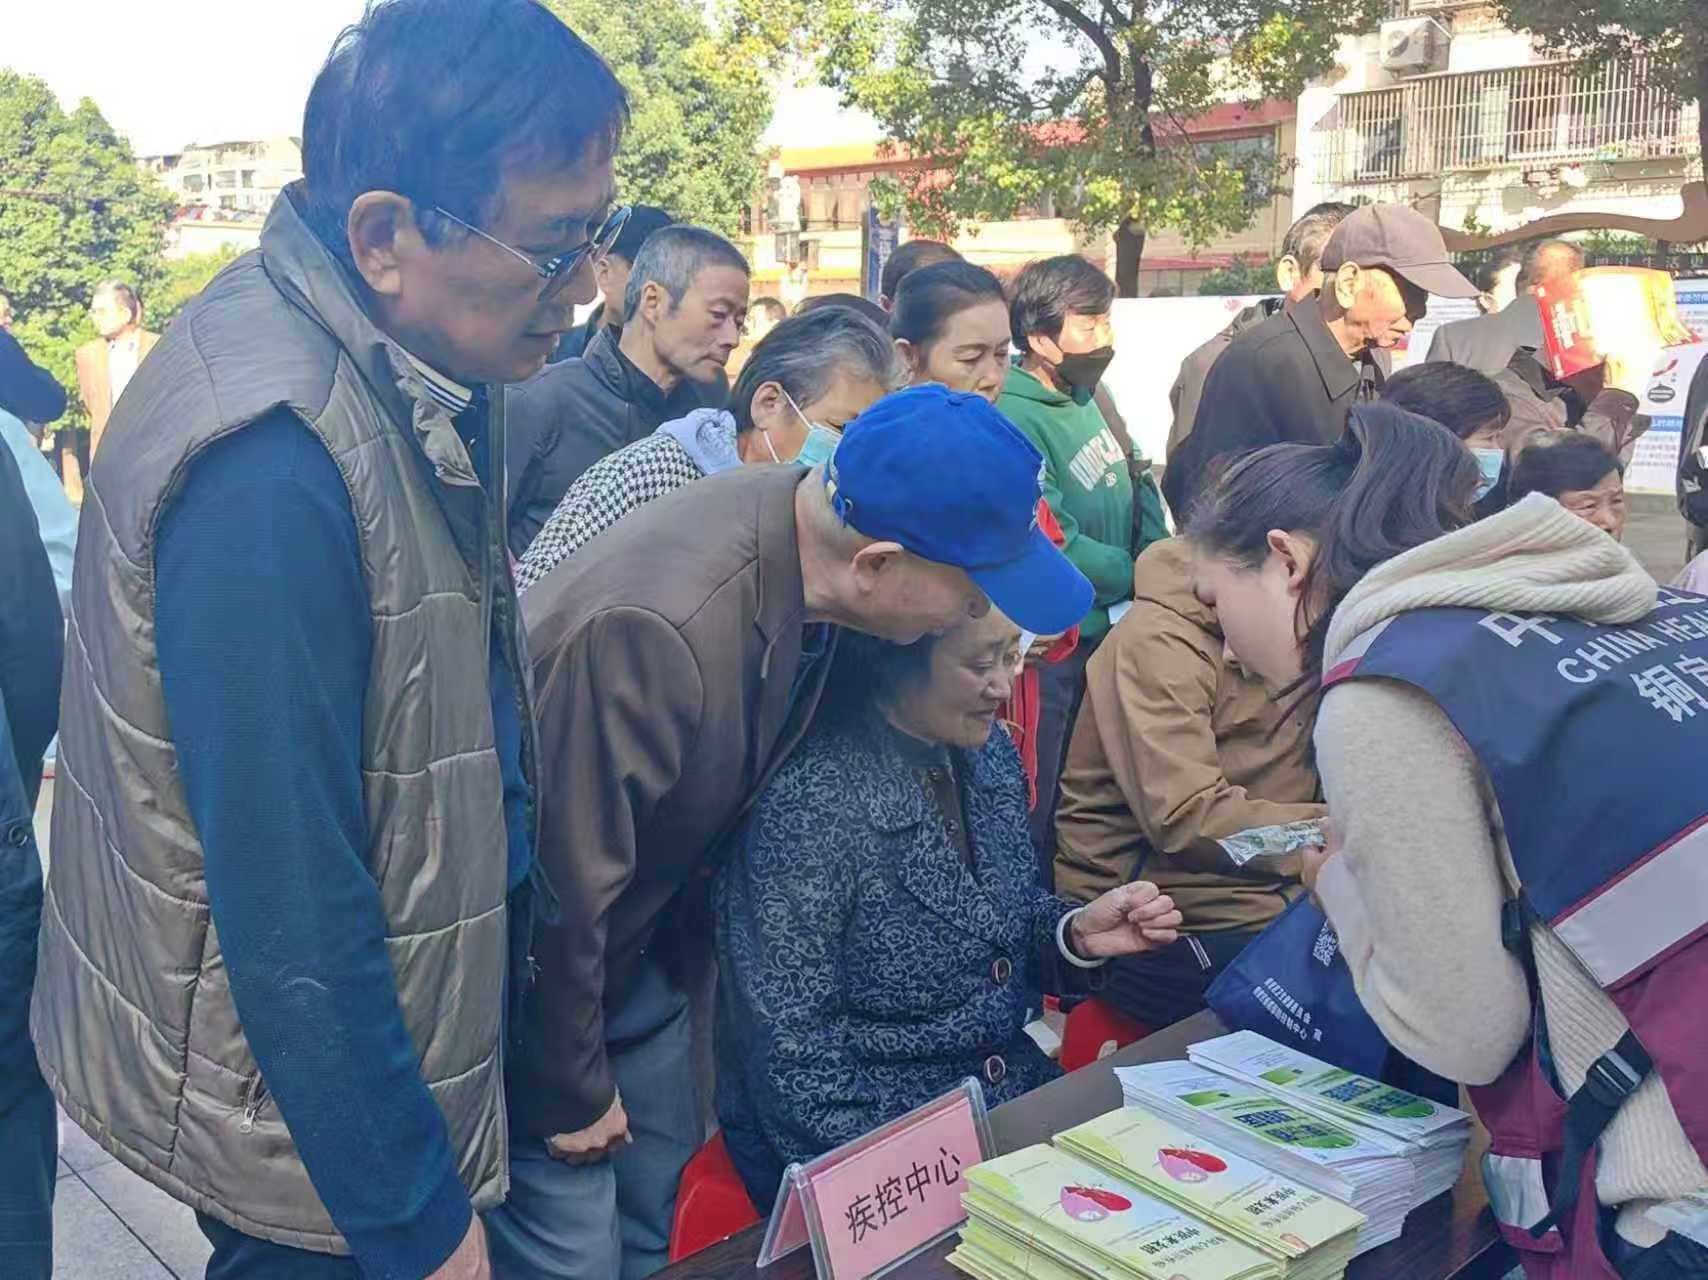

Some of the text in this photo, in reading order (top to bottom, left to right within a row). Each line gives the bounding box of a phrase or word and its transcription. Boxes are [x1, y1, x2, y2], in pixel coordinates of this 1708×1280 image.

[1556, 628, 1669, 684] CHINA
[844, 1146, 961, 1245] 疾控中心
